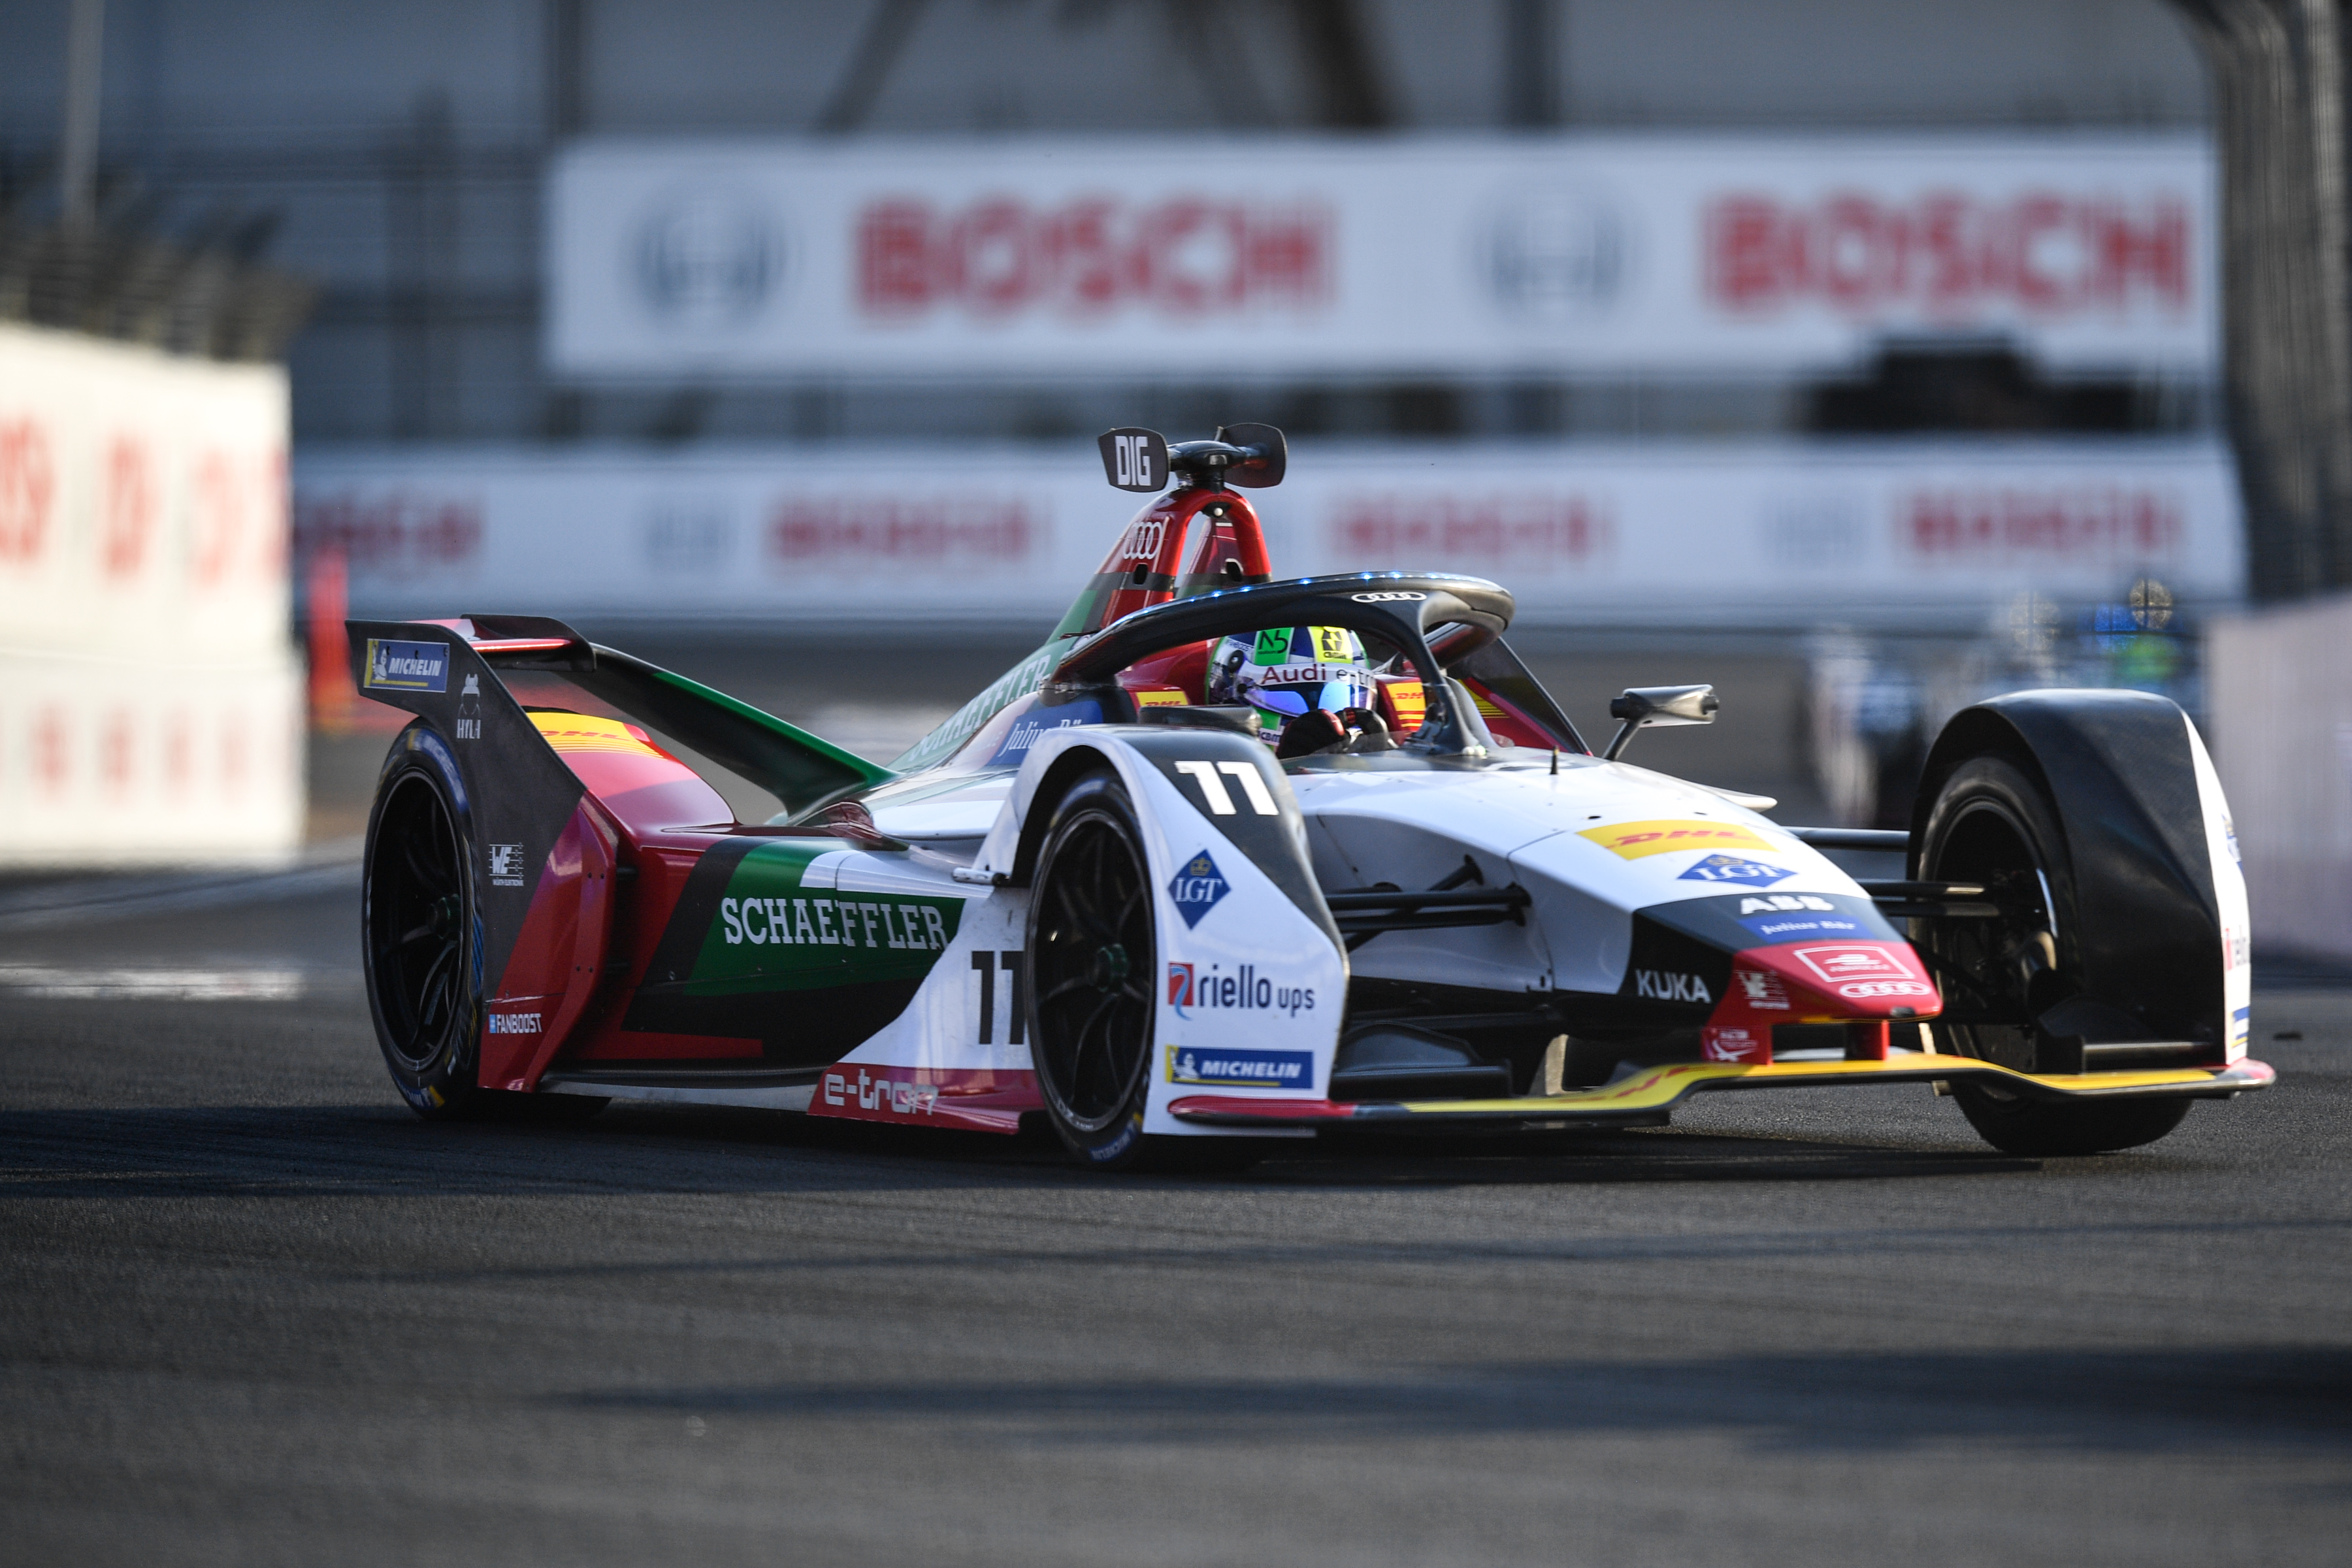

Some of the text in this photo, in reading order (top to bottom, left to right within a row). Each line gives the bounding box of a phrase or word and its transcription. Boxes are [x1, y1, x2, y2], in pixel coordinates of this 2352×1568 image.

[855, 193, 1336, 321] BOSCH
[1703, 192, 2190, 321] BOSCH
[1115, 435, 1152, 487] DIG
[388, 657, 443, 677] MICHELIN
[1261, 664, 1326, 685] Audi
[457, 719, 481, 739] HYLA
[998, 721, 1045, 757] Juliu
[1174, 760, 1280, 816] 11
[1614, 830, 1752, 845] DHL
[1176, 877, 1223, 902] LGT
[1693, 864, 1782, 881] LGT
[1740, 895, 1835, 915] ABB
[721, 897, 949, 951] SCHAEFFLER
[972, 951, 1024, 1045] 11
[1199, 964, 1315, 1017] riello ups
[1636, 968, 1712, 1004] KUKA
[497, 1013, 542, 1034] FANBOOST
[1201, 1060, 1301, 1079] MICHELIN
[825, 1068, 939, 1116] e-tron
